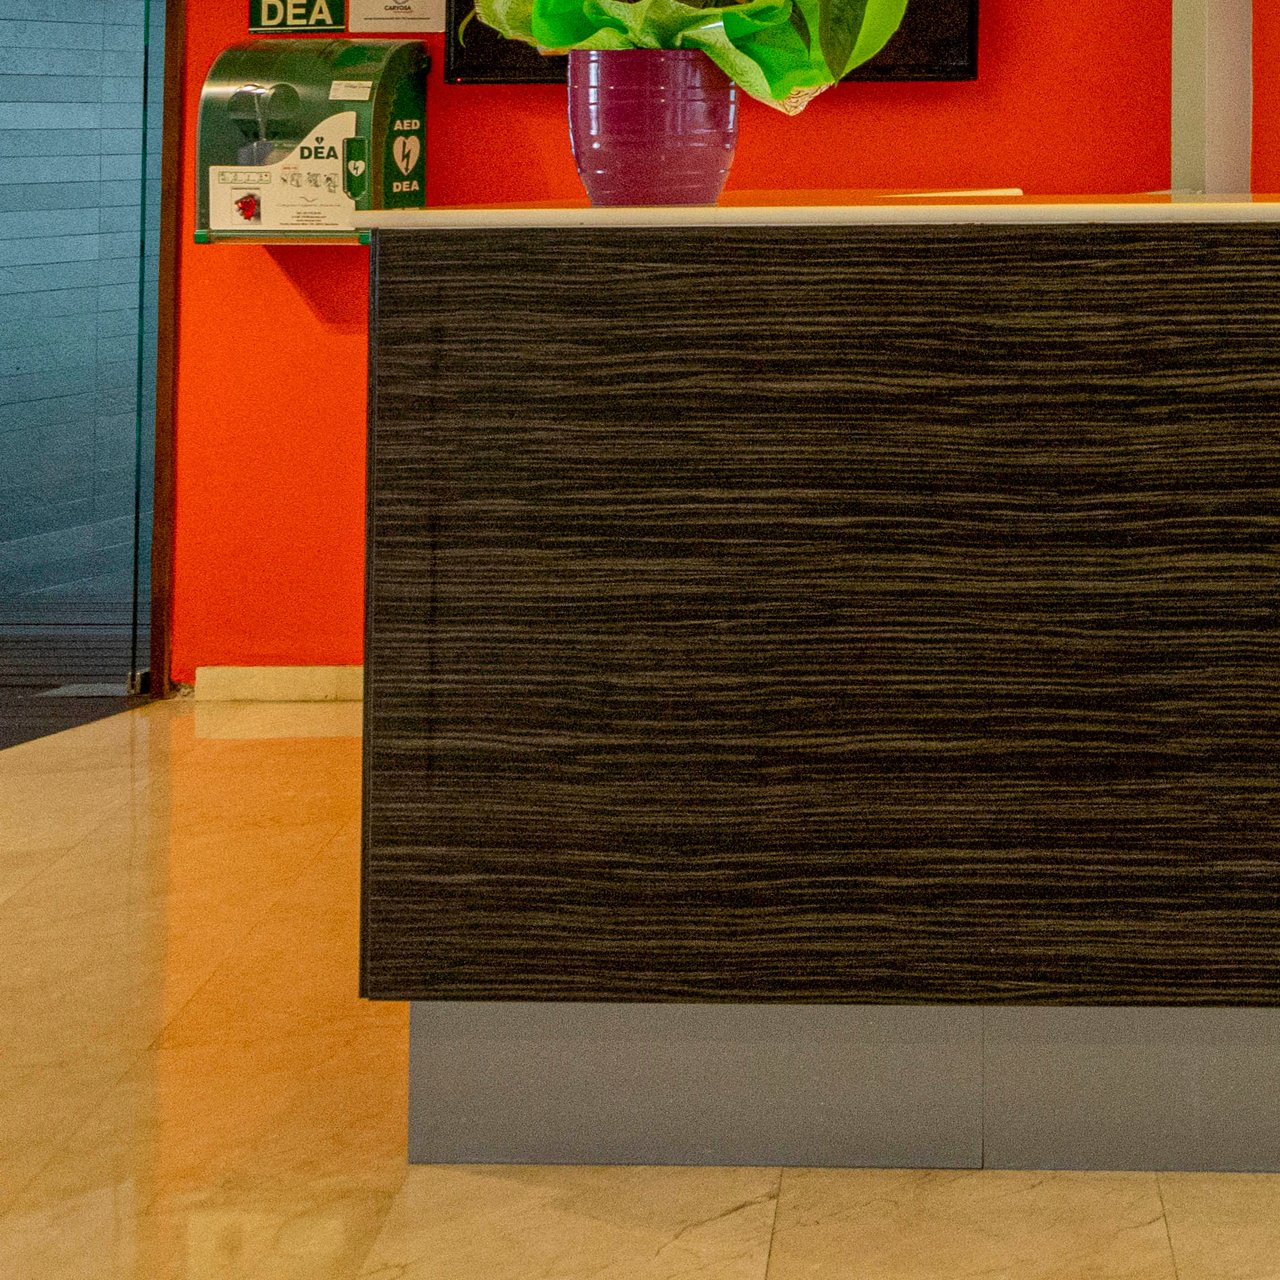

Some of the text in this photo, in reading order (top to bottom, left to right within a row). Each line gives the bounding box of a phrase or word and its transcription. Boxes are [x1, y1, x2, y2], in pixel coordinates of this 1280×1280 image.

[394, 119, 421, 131] AED
[299, 146, 339, 160] DEA
[393, 180, 420, 193] DEA
